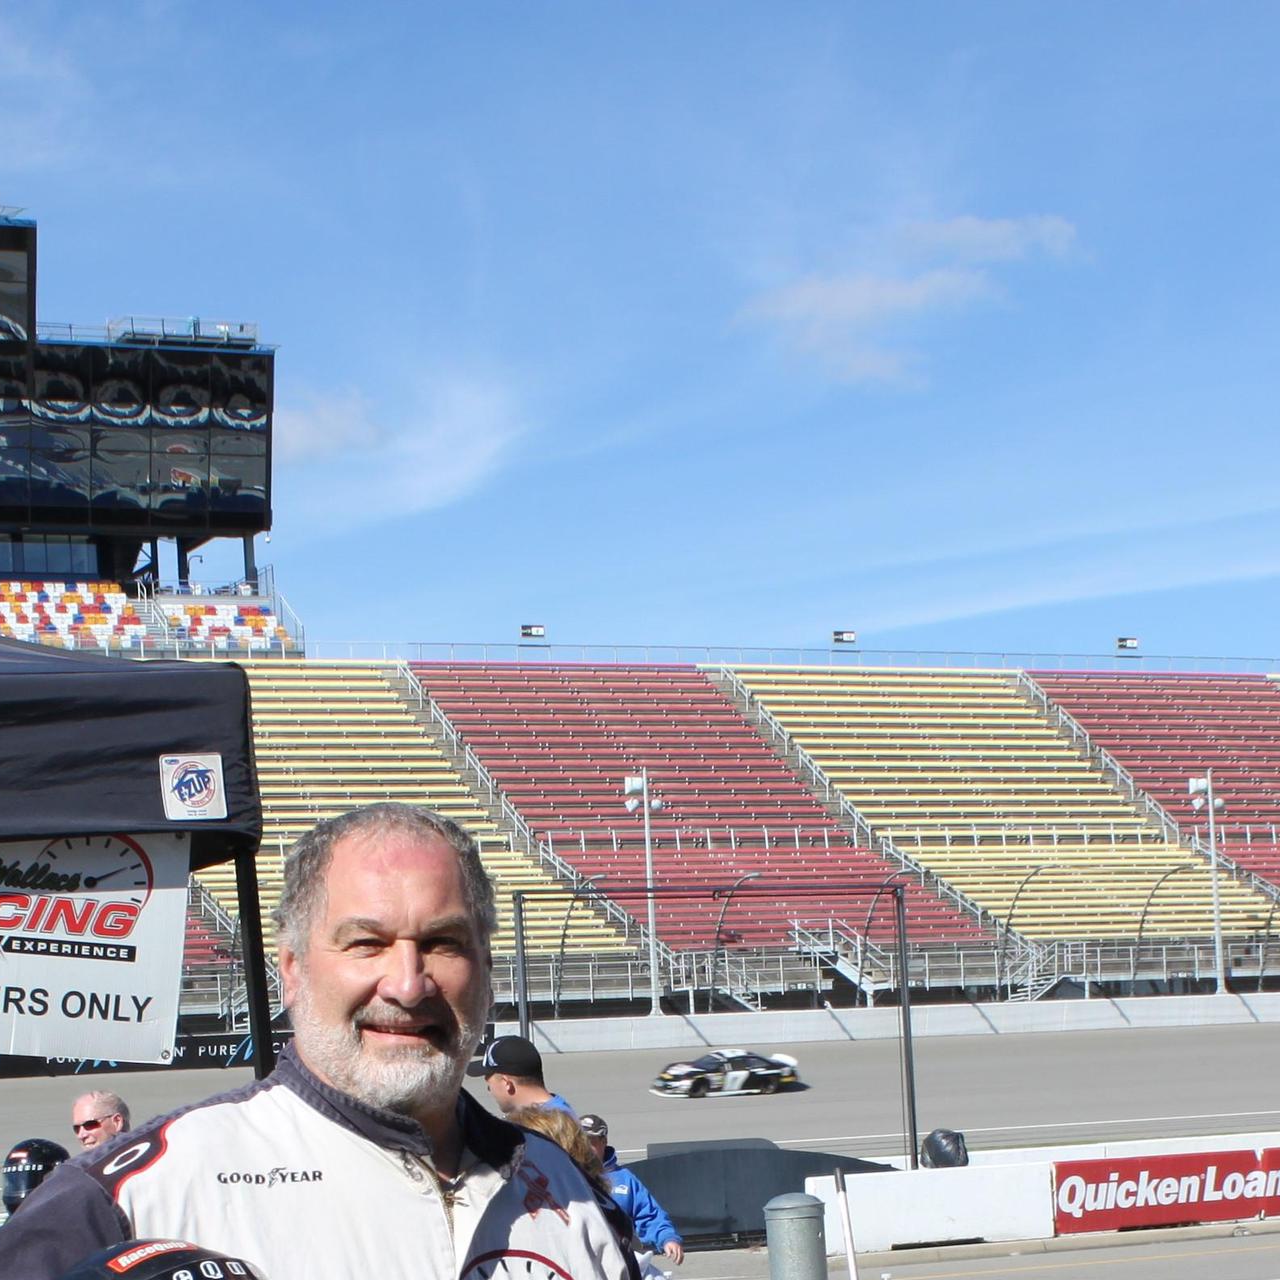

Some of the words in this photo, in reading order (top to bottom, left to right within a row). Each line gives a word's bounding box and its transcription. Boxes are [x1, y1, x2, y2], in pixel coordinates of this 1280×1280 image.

[11, 939, 129, 959] EXPERIENCE
[60, 991, 154, 1024] ONLY
[1058, 1169, 1202, 1218] Quicken
[117, 1241, 188, 1269] RaceQuip
